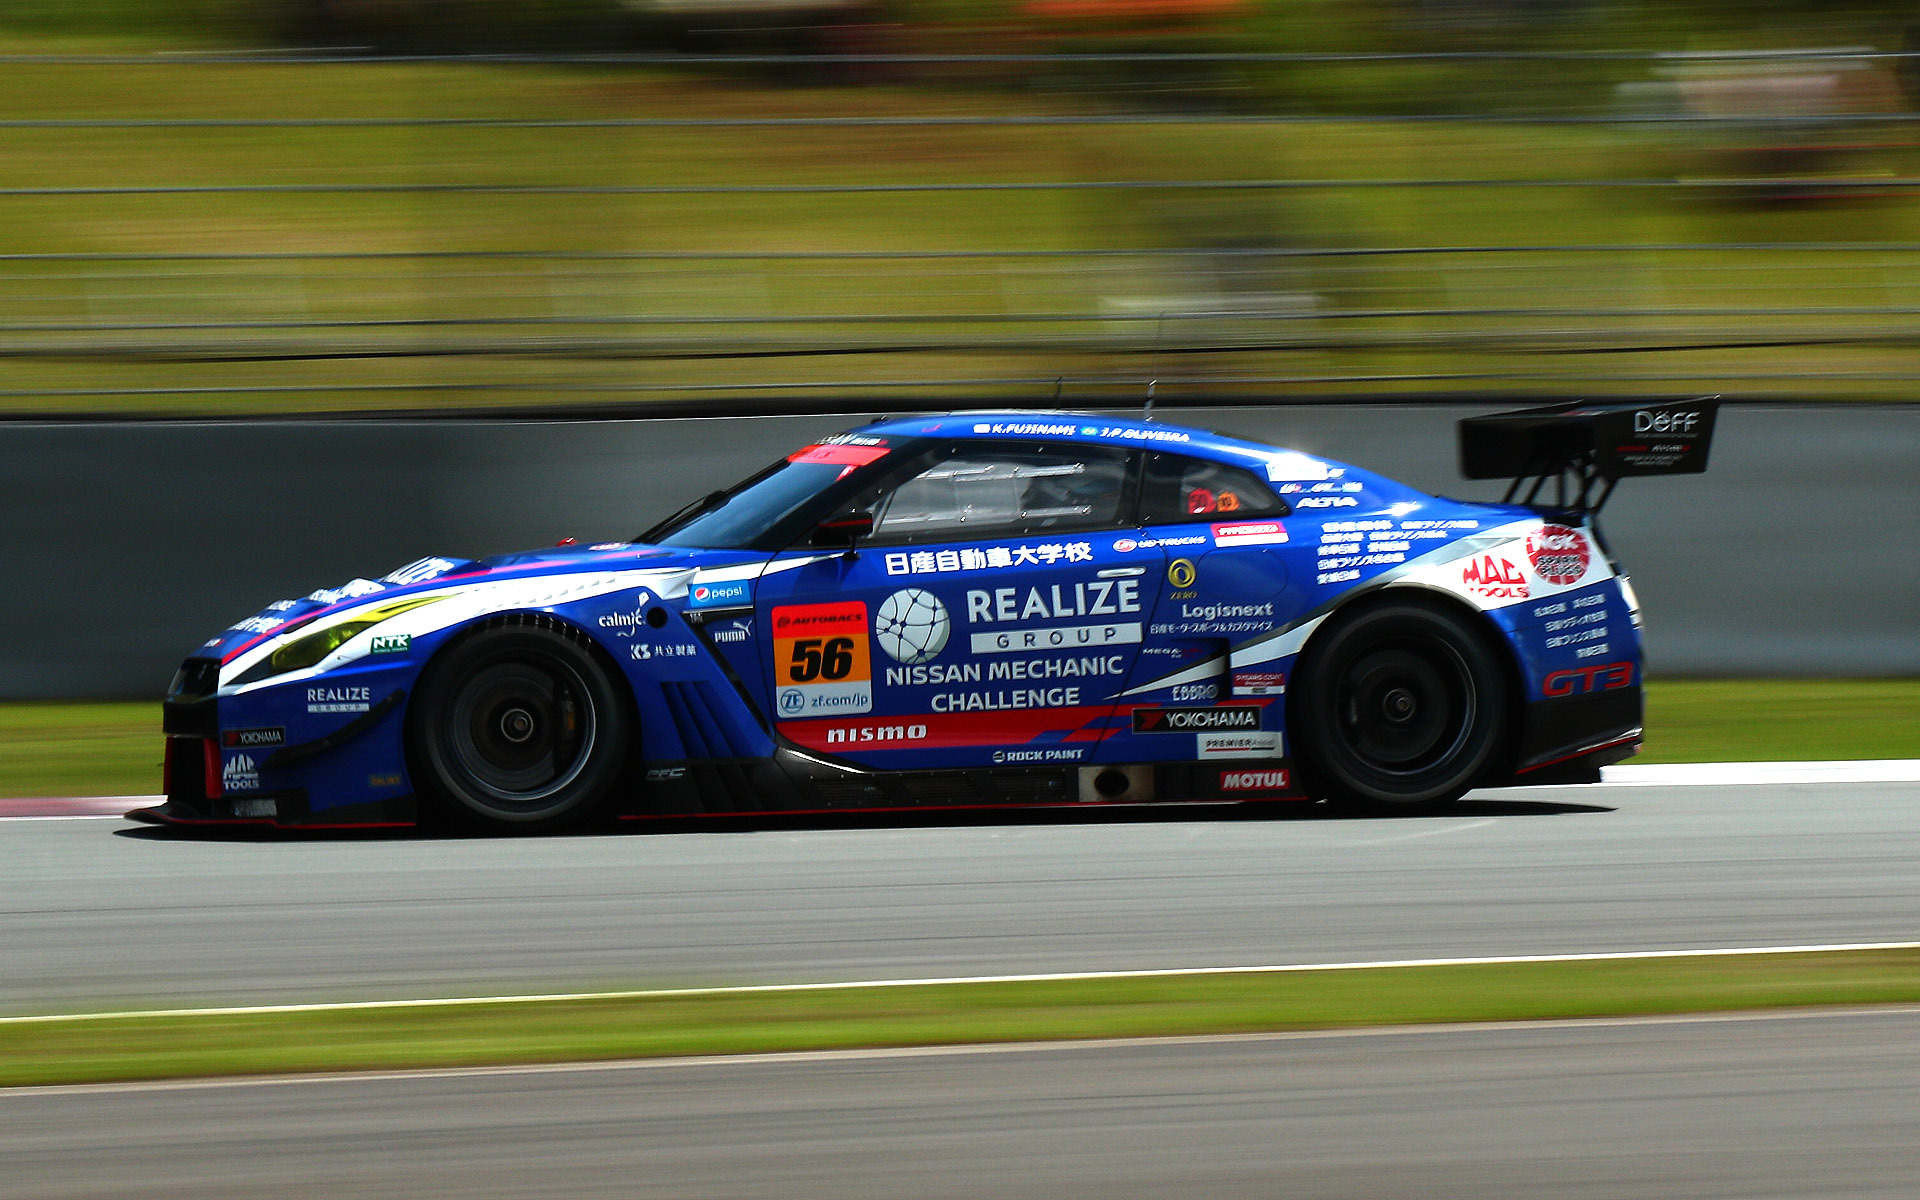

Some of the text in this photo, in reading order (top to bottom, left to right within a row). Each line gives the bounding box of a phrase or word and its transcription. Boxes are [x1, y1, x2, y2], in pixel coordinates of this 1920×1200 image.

[885, 541, 1094, 576] 日産自動車大学校
[711, 586, 743, 601] pepsi
[966, 579, 1142, 623] REALIZE
[791, 614, 863, 626] AUTOBACS
[1182, 602, 1274, 621] Logisnext
[373, 634, 409, 649] NTK
[996, 627, 1118, 649] GROUP
[790, 637, 855, 683] 56
[886, 655, 1125, 687] NISSAN MECHANIC
[1541, 661, 1634, 698] GT3
[307, 687, 370, 702] REALIZE
[811, 693, 869, 709] zf.com/jp
[931, 687, 1081, 713] CHALLENGE
[1165, 711, 1257, 729] YOKOHAMA
[240, 729, 282, 744] YOKOHAMA
[826, 724, 928, 744] nismo
[1205, 738, 1251, 748] PREMIER
[1007, 748, 1085, 762] ROCK PAINT
[223, 779, 260, 791] TOOLS
[1223, 772, 1287, 790] MOTUL
